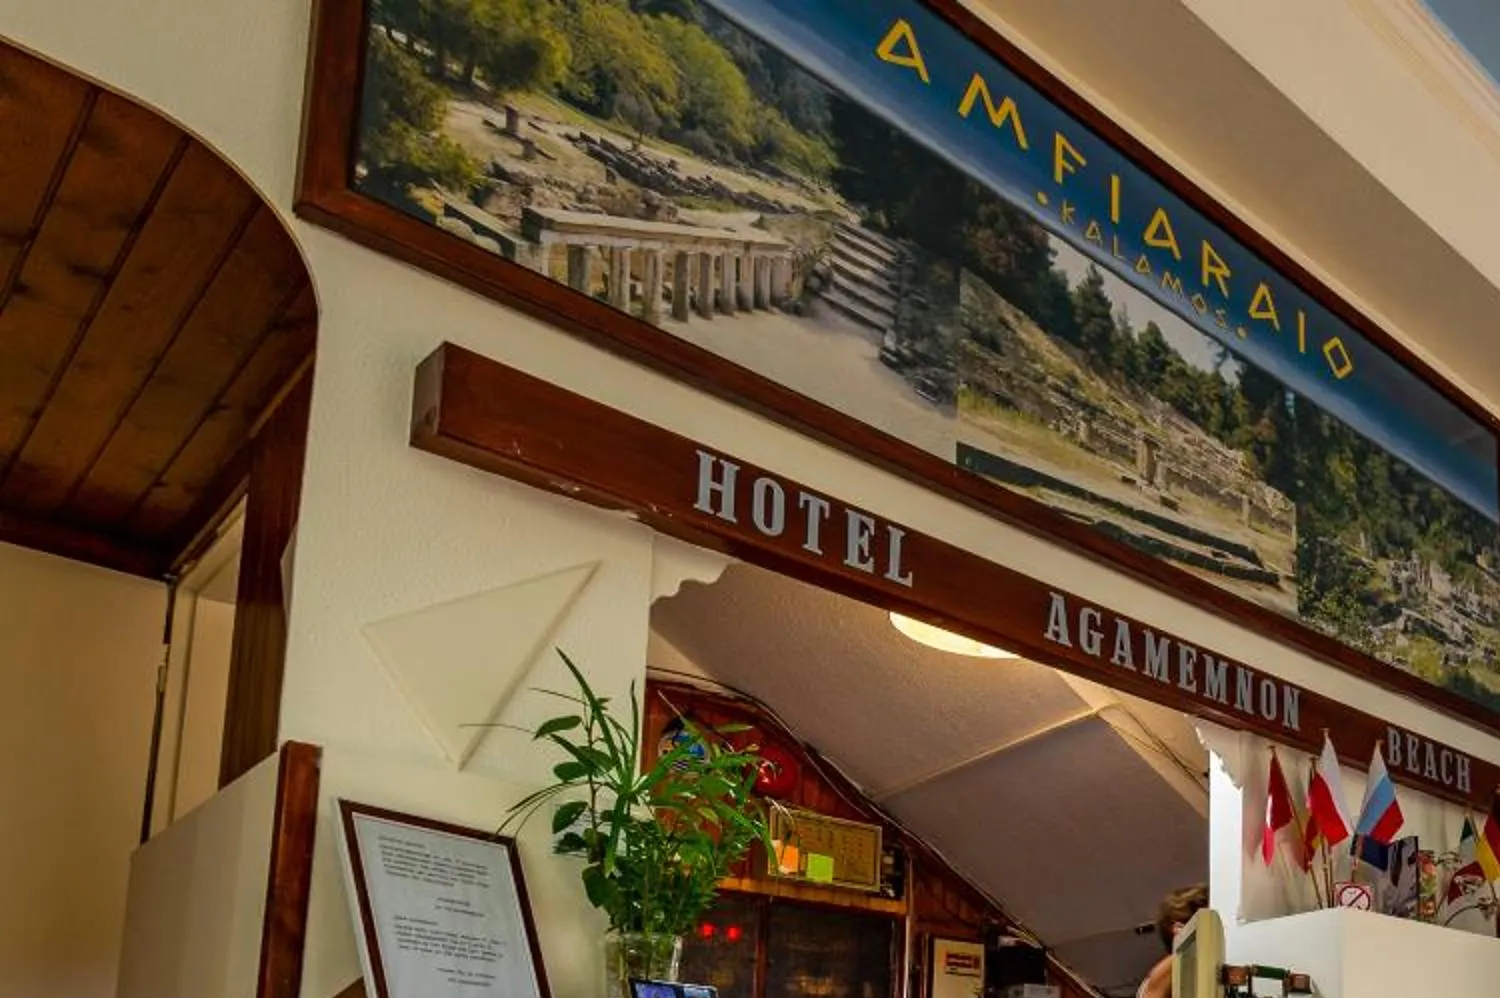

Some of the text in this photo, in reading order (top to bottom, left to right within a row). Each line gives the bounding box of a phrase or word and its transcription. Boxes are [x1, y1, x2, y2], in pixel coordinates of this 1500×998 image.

[876, 19, 1354, 379] AMFIARAIO
[1060, 200, 1227, 329] KALAMOS
[694, 450, 1471, 793] HOTEL AGAMEMNON BEACH
